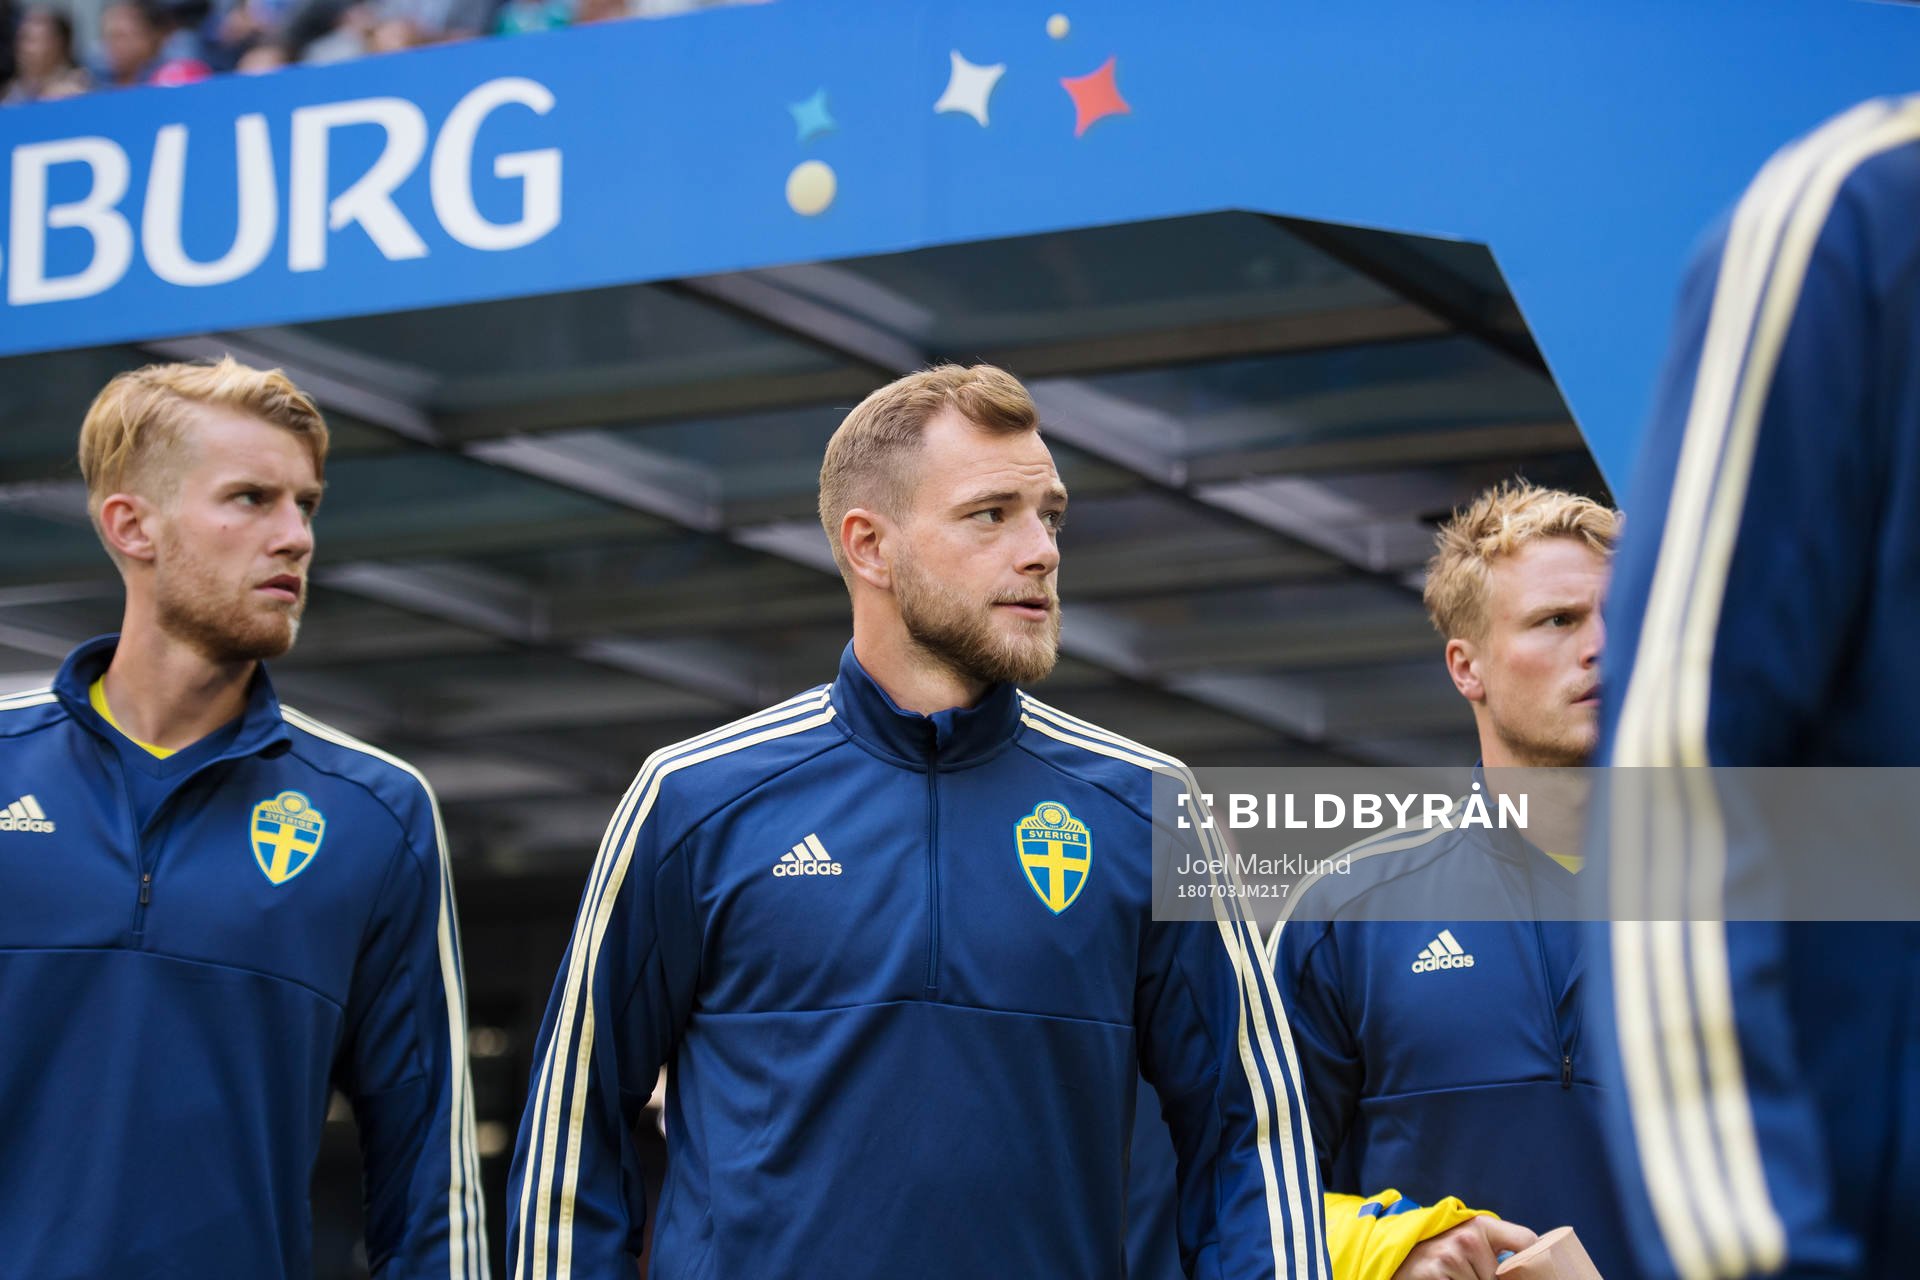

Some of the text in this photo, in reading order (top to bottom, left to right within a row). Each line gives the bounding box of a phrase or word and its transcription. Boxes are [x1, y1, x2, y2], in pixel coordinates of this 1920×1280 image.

[0, 77, 562, 306] BURG
[0, 817, 55, 833] didas
[1028, 829, 1080, 842] SVERIGE
[772, 860, 843, 877] adidas
[1411, 954, 1475, 974] adidas
